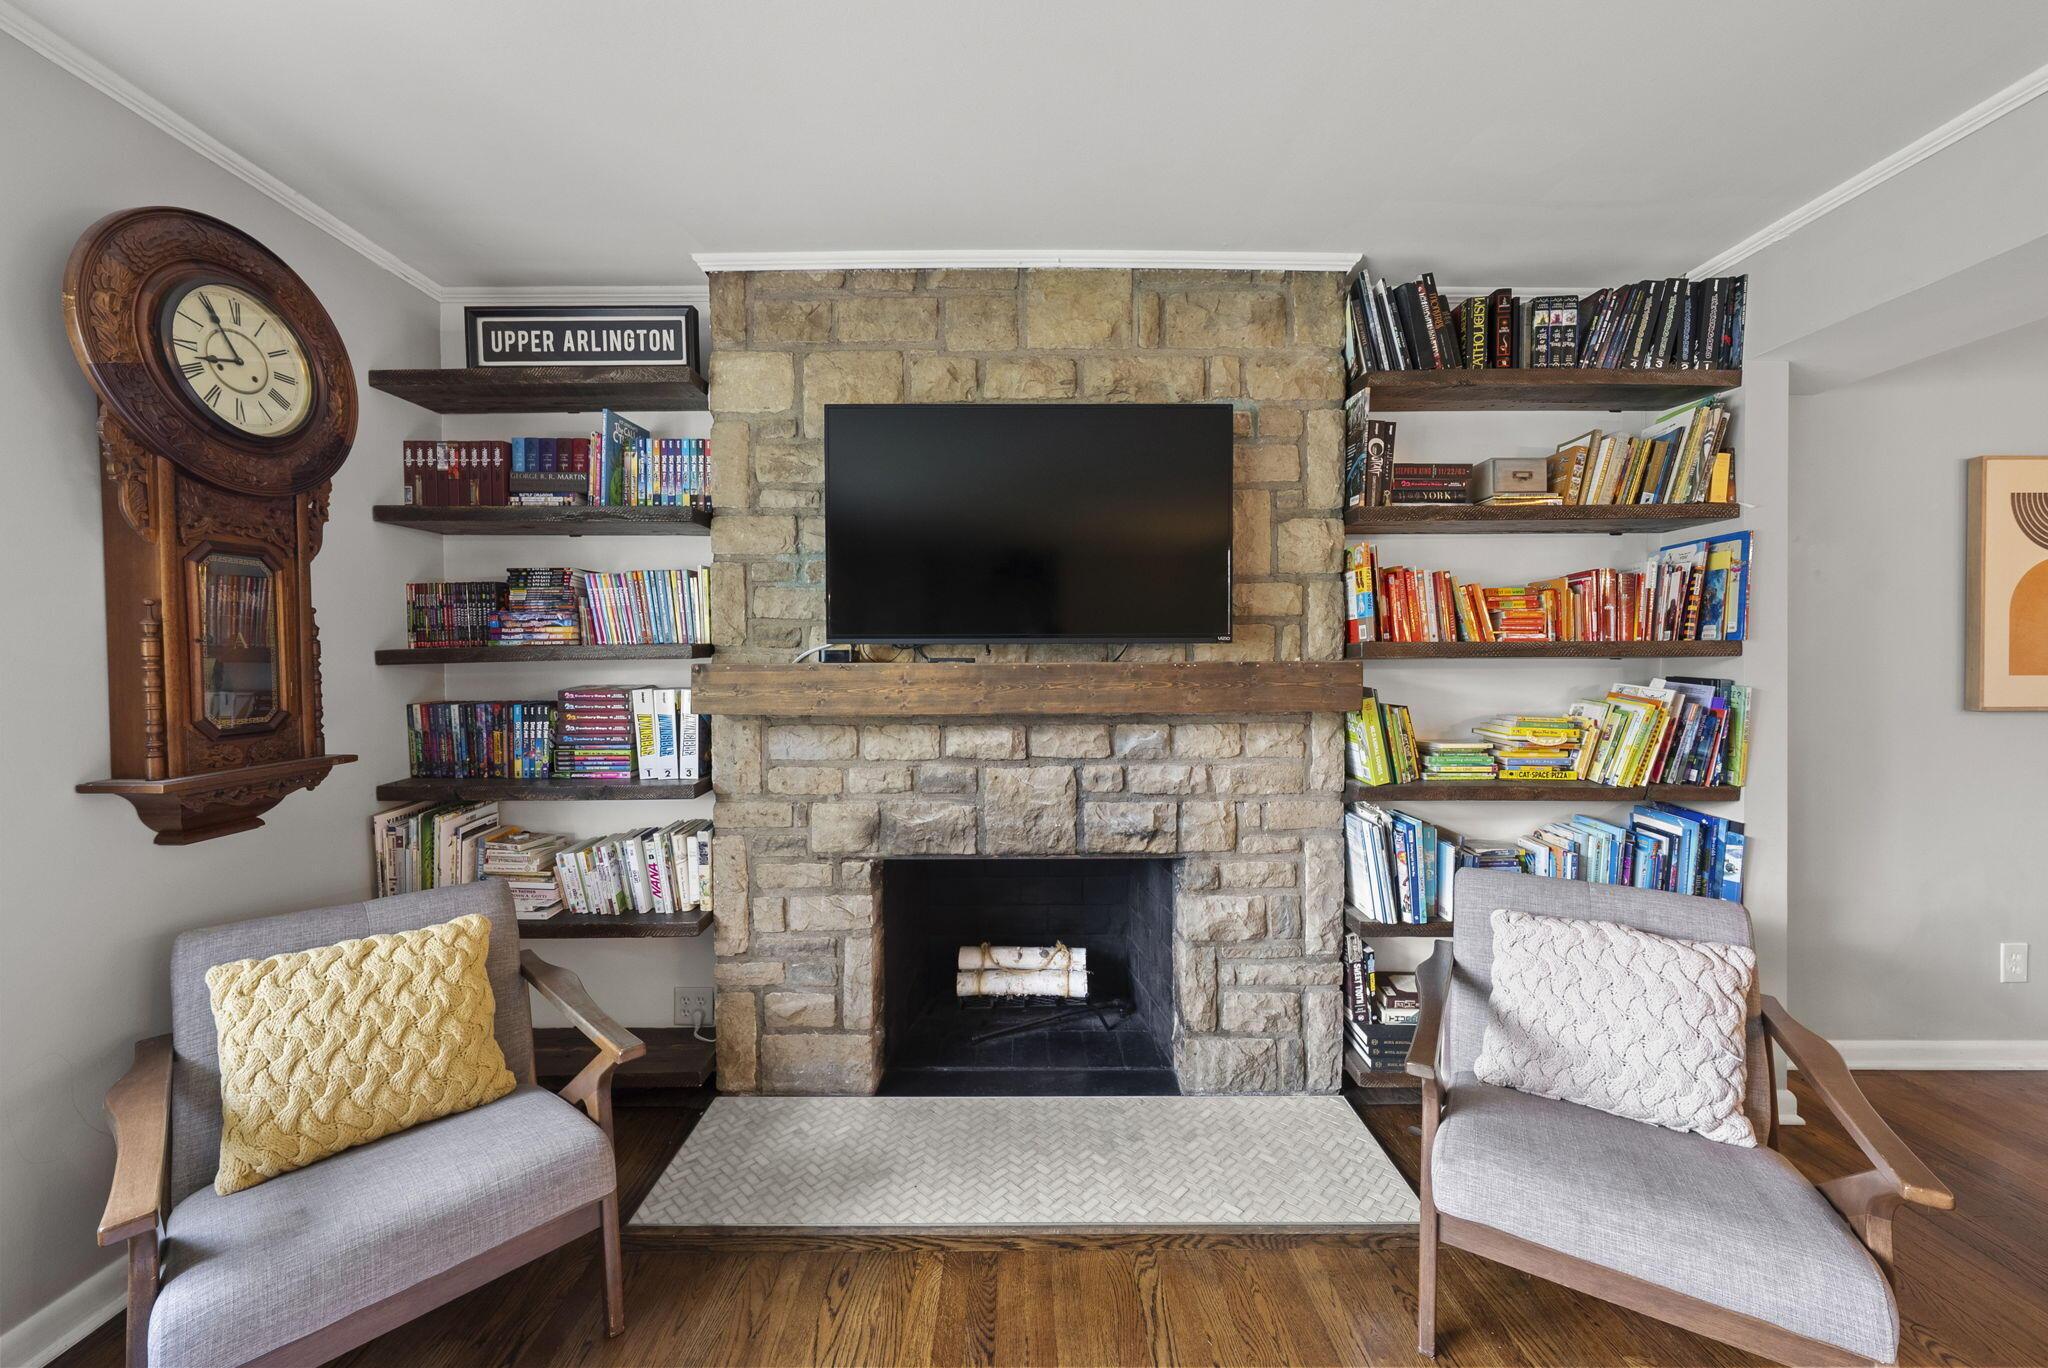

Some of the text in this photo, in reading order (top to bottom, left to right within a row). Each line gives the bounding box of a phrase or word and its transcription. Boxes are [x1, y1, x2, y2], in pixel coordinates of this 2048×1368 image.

[268, 349, 289, 358] II
[491, 329, 675, 353] UPPER ARLINGTON
[274, 372, 298, 385] III
[1630, 359, 1638, 369] 4
[1655, 360, 1663, 368] 3
[268, 388, 292, 411] IIII
[1368, 438, 1385, 477] OUTCAST
[637, 714, 656, 757] INVINCIBLE
[658, 714, 674, 757] INVINCIBLE
[682, 713, 696, 756] INVINCIBLE
[648, 863, 662, 898] NANA
[1353, 963, 1364, 1004] SWEET TOOTH
